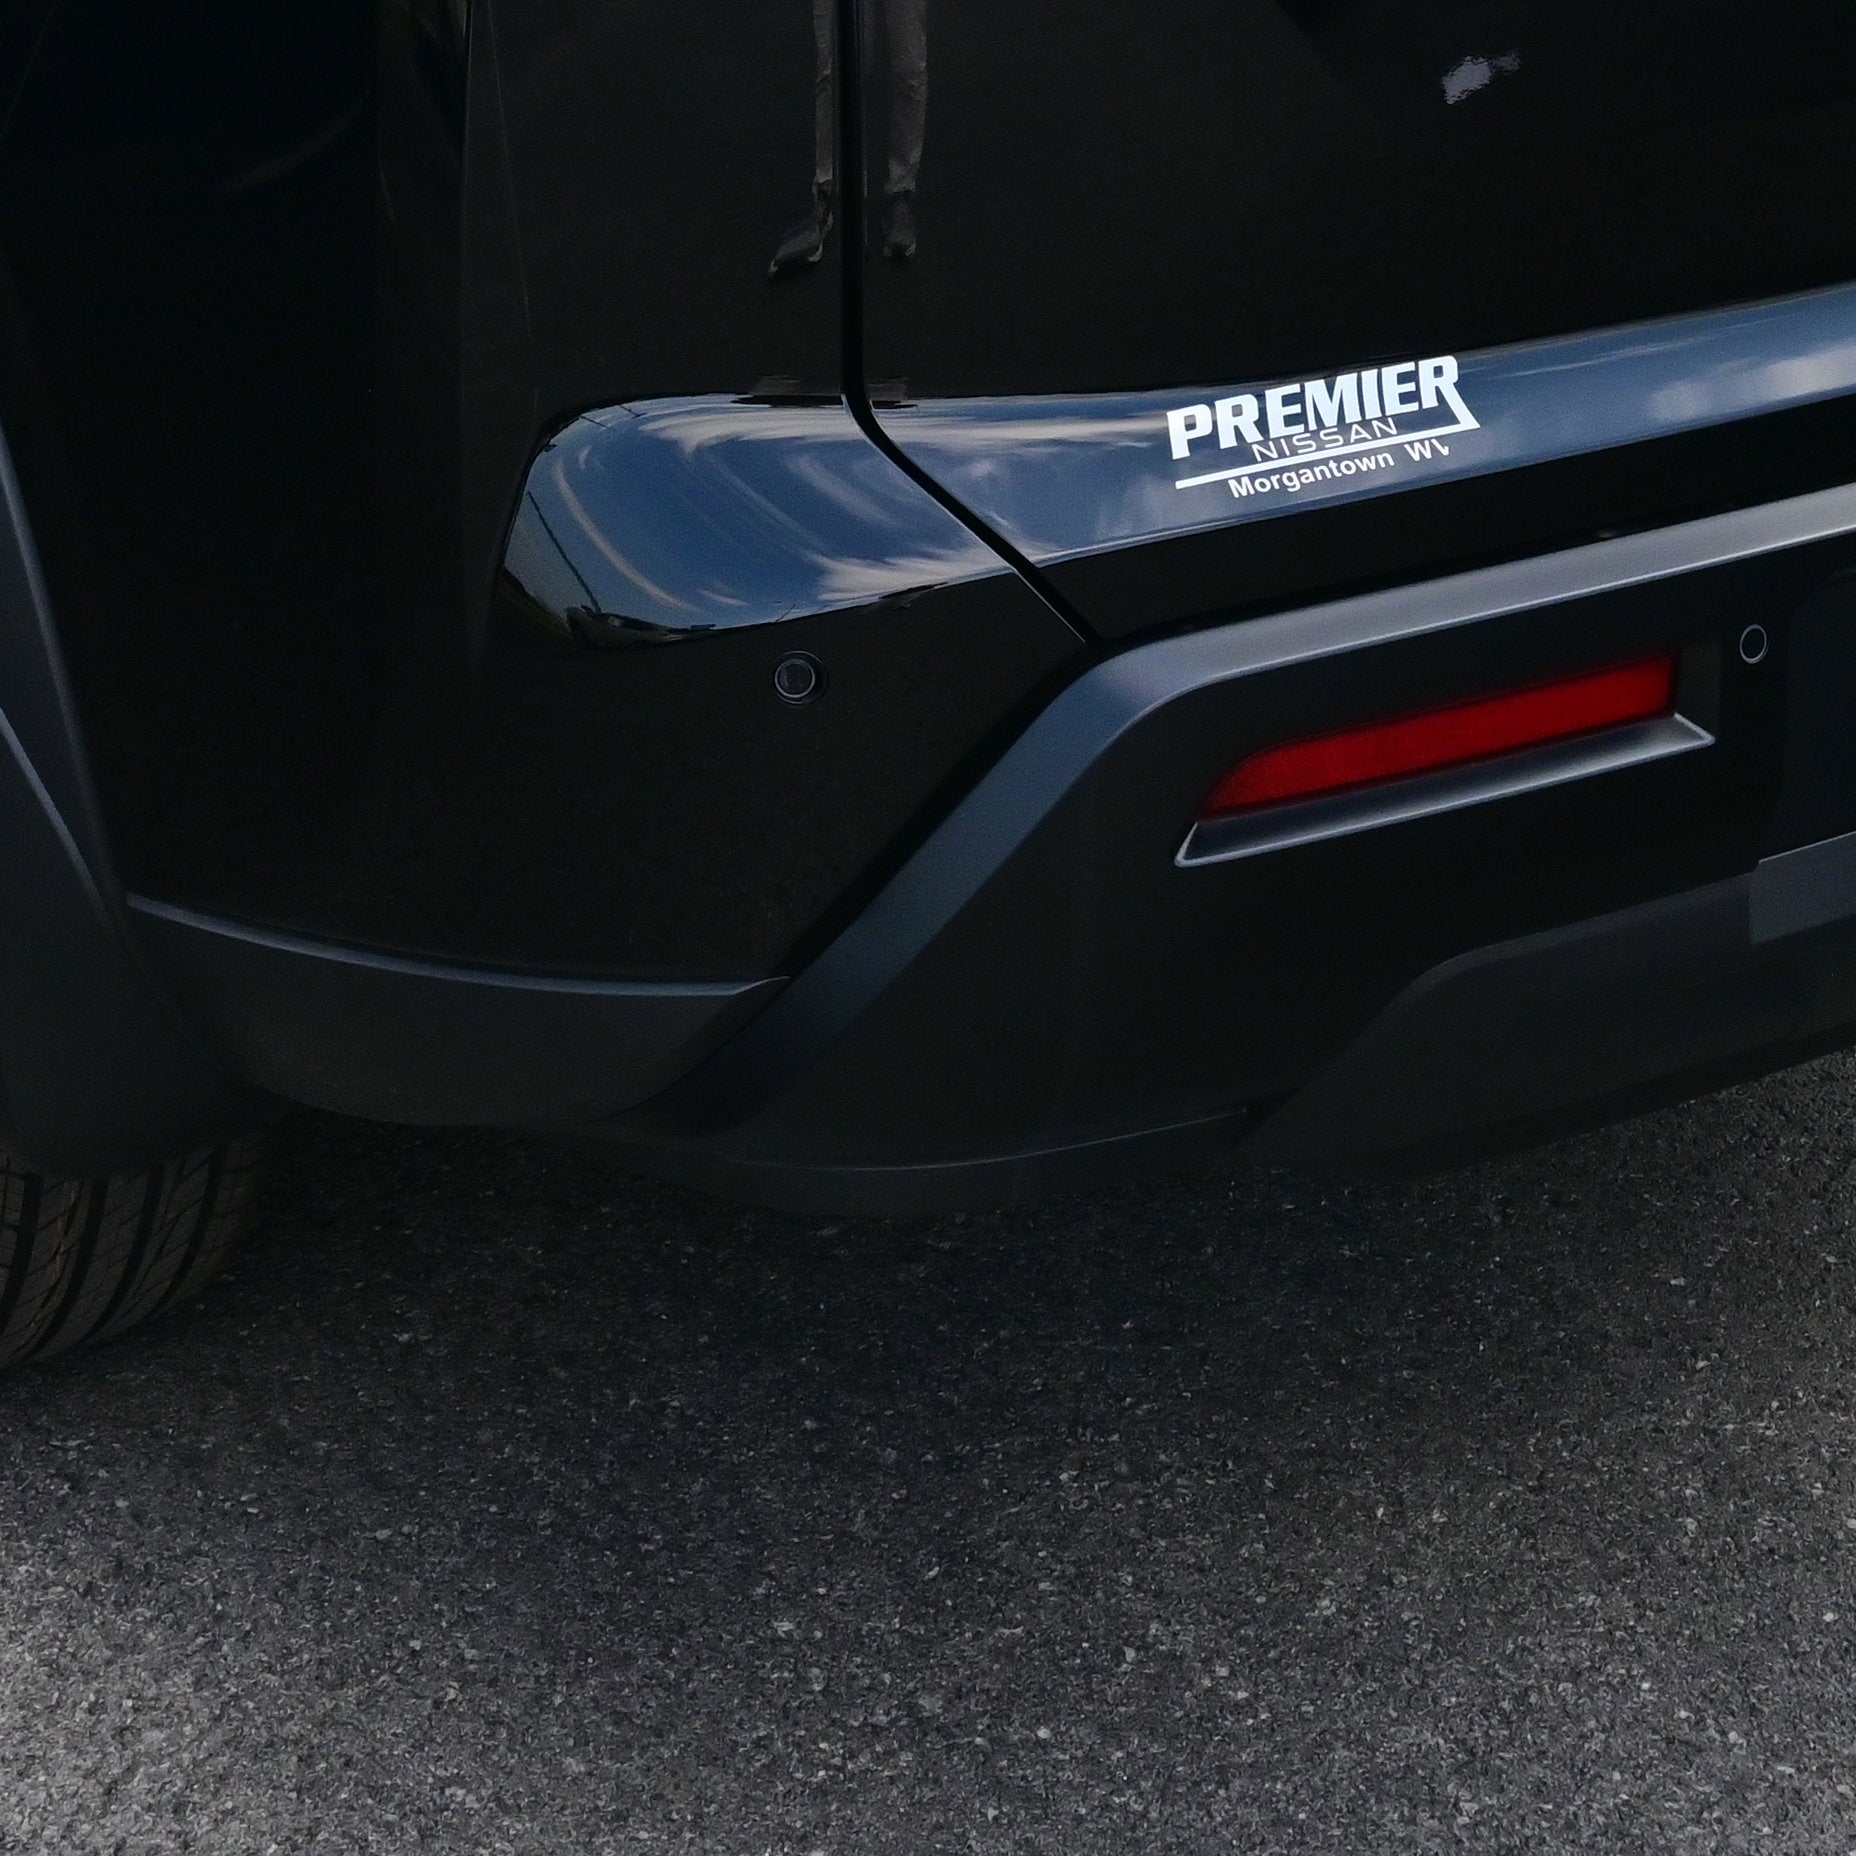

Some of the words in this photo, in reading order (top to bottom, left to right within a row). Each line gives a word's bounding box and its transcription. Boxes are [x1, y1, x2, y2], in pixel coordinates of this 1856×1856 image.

[1166, 354, 1481, 461] PREMIER
[1251, 416, 1398, 463] NISSAN
[1227, 450, 1396, 499] Morgantown
